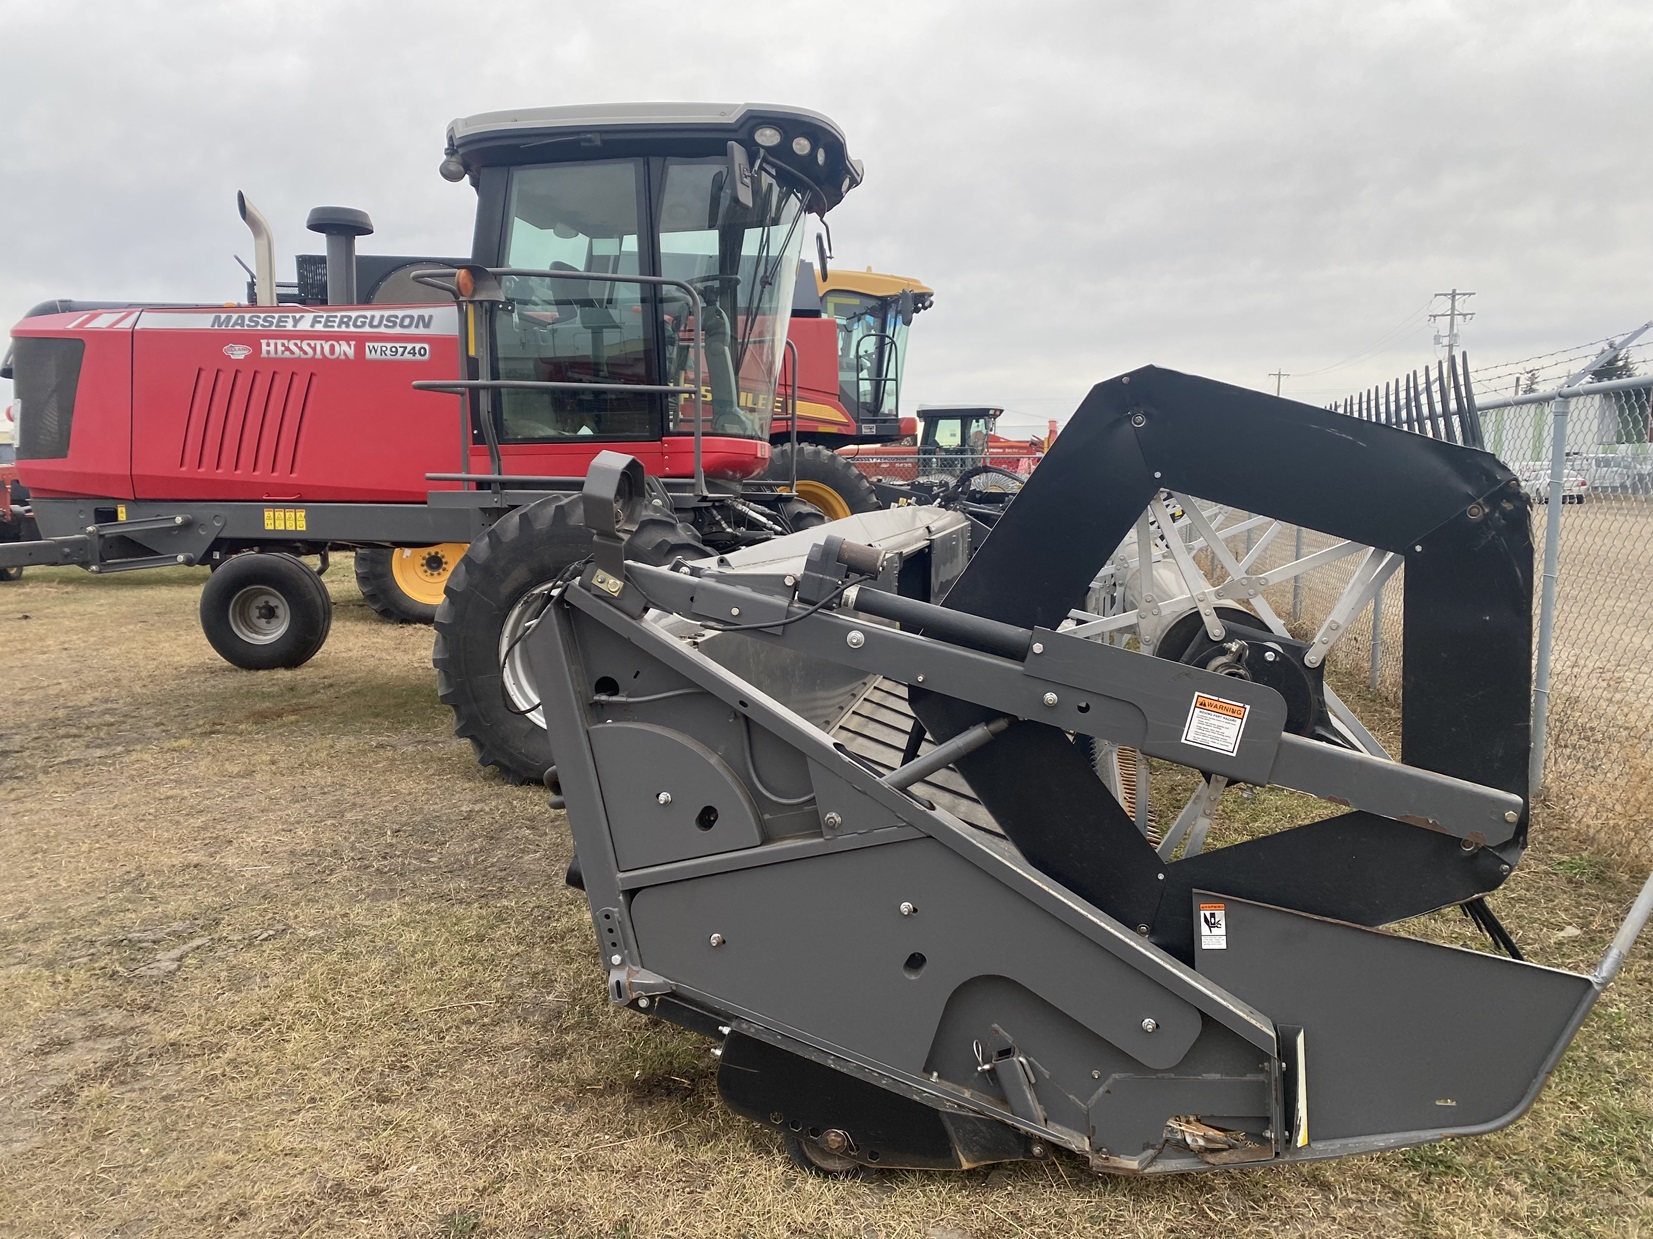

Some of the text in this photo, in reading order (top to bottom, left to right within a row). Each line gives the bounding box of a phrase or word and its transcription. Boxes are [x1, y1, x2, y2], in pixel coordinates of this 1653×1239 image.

[210, 314, 433, 329] MASSEY FERGUSON
[260, 339, 356, 360] HESSTON
[367, 344, 428, 358] WR9740
[1207, 701, 1242, 716] WARNING
